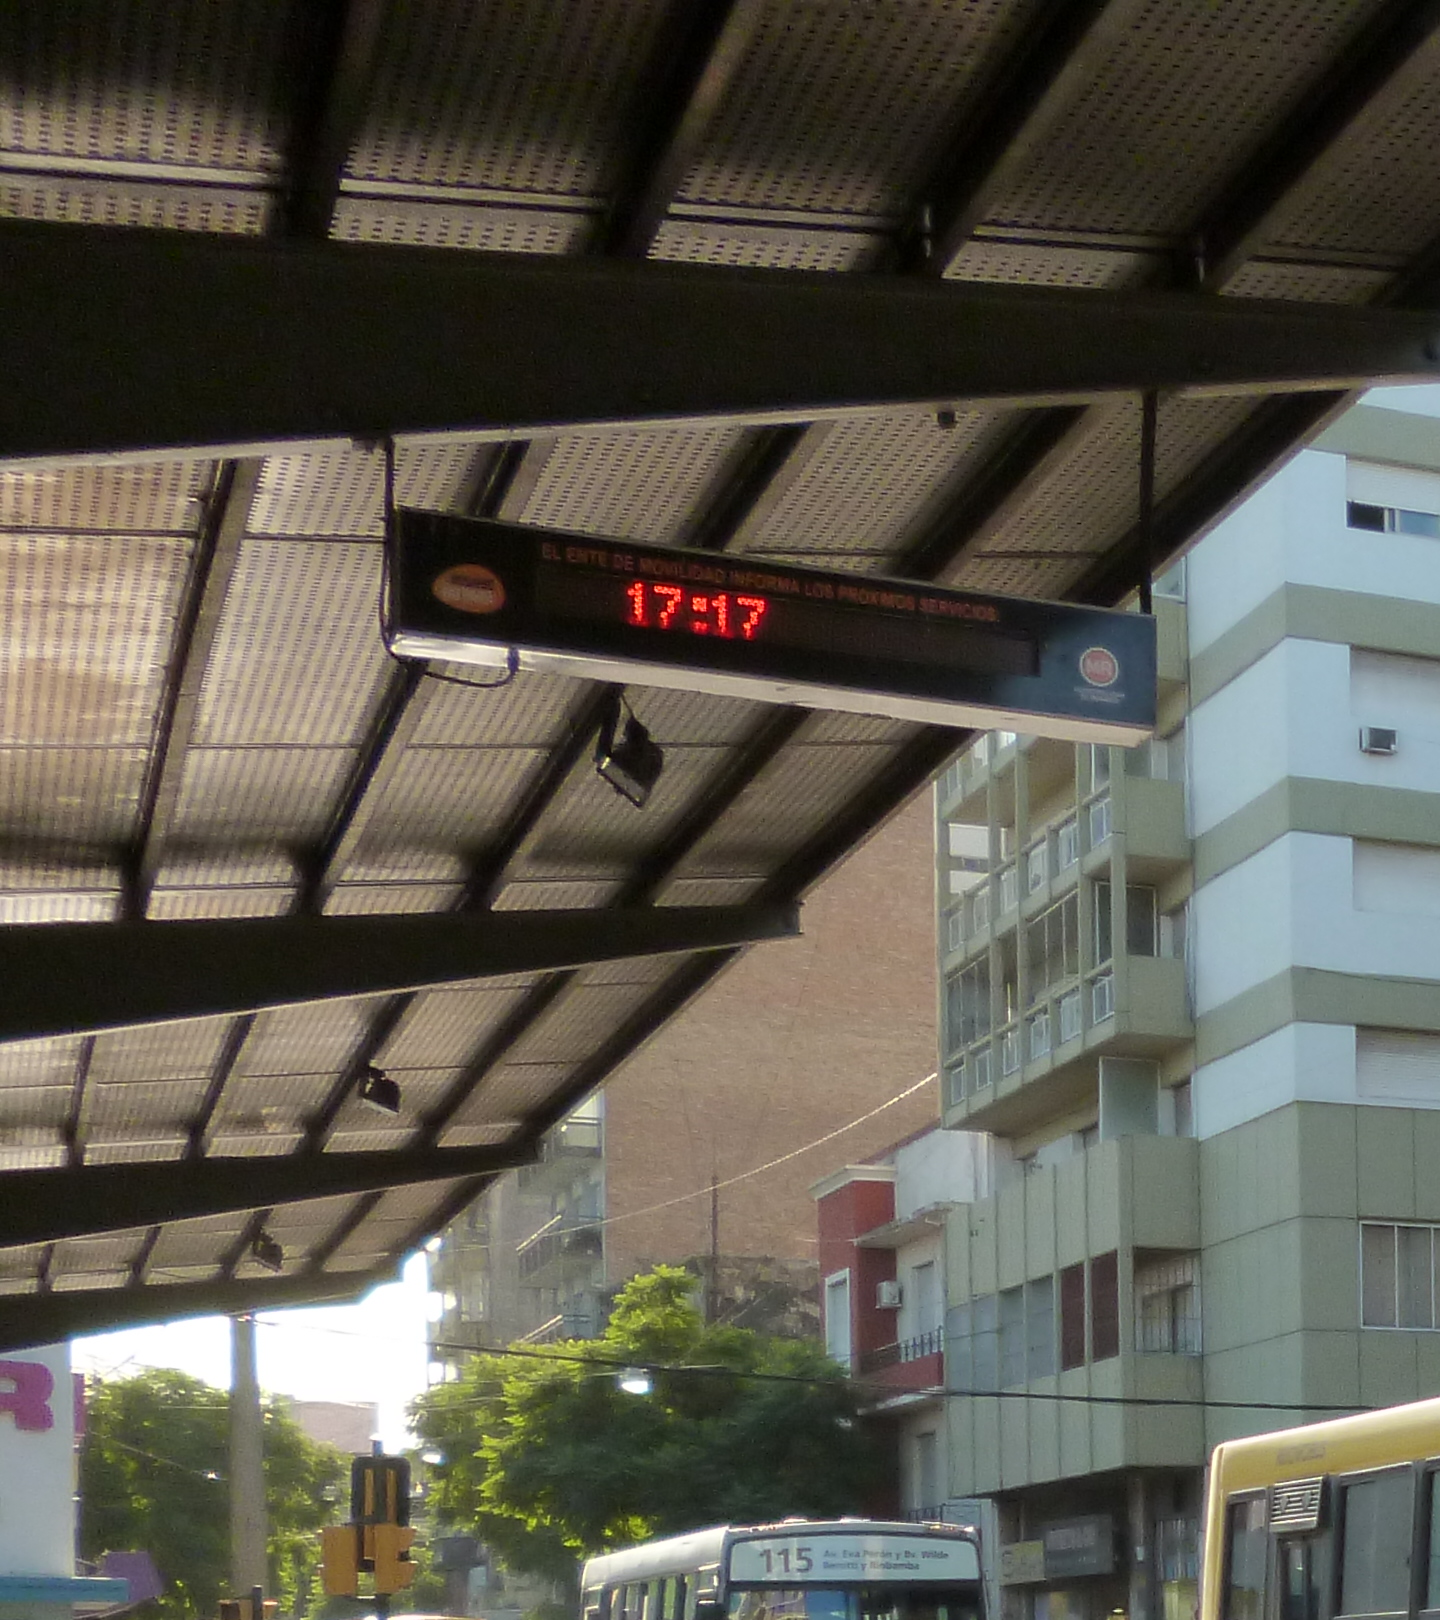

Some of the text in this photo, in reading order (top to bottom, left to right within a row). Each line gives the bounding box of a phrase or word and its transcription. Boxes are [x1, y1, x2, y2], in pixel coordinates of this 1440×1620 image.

[542, 543, 561, 560] EL
[613, 553, 634, 571] DE
[626, 580, 768, 641] 17:17
[759, 1547, 814, 1574] 115
